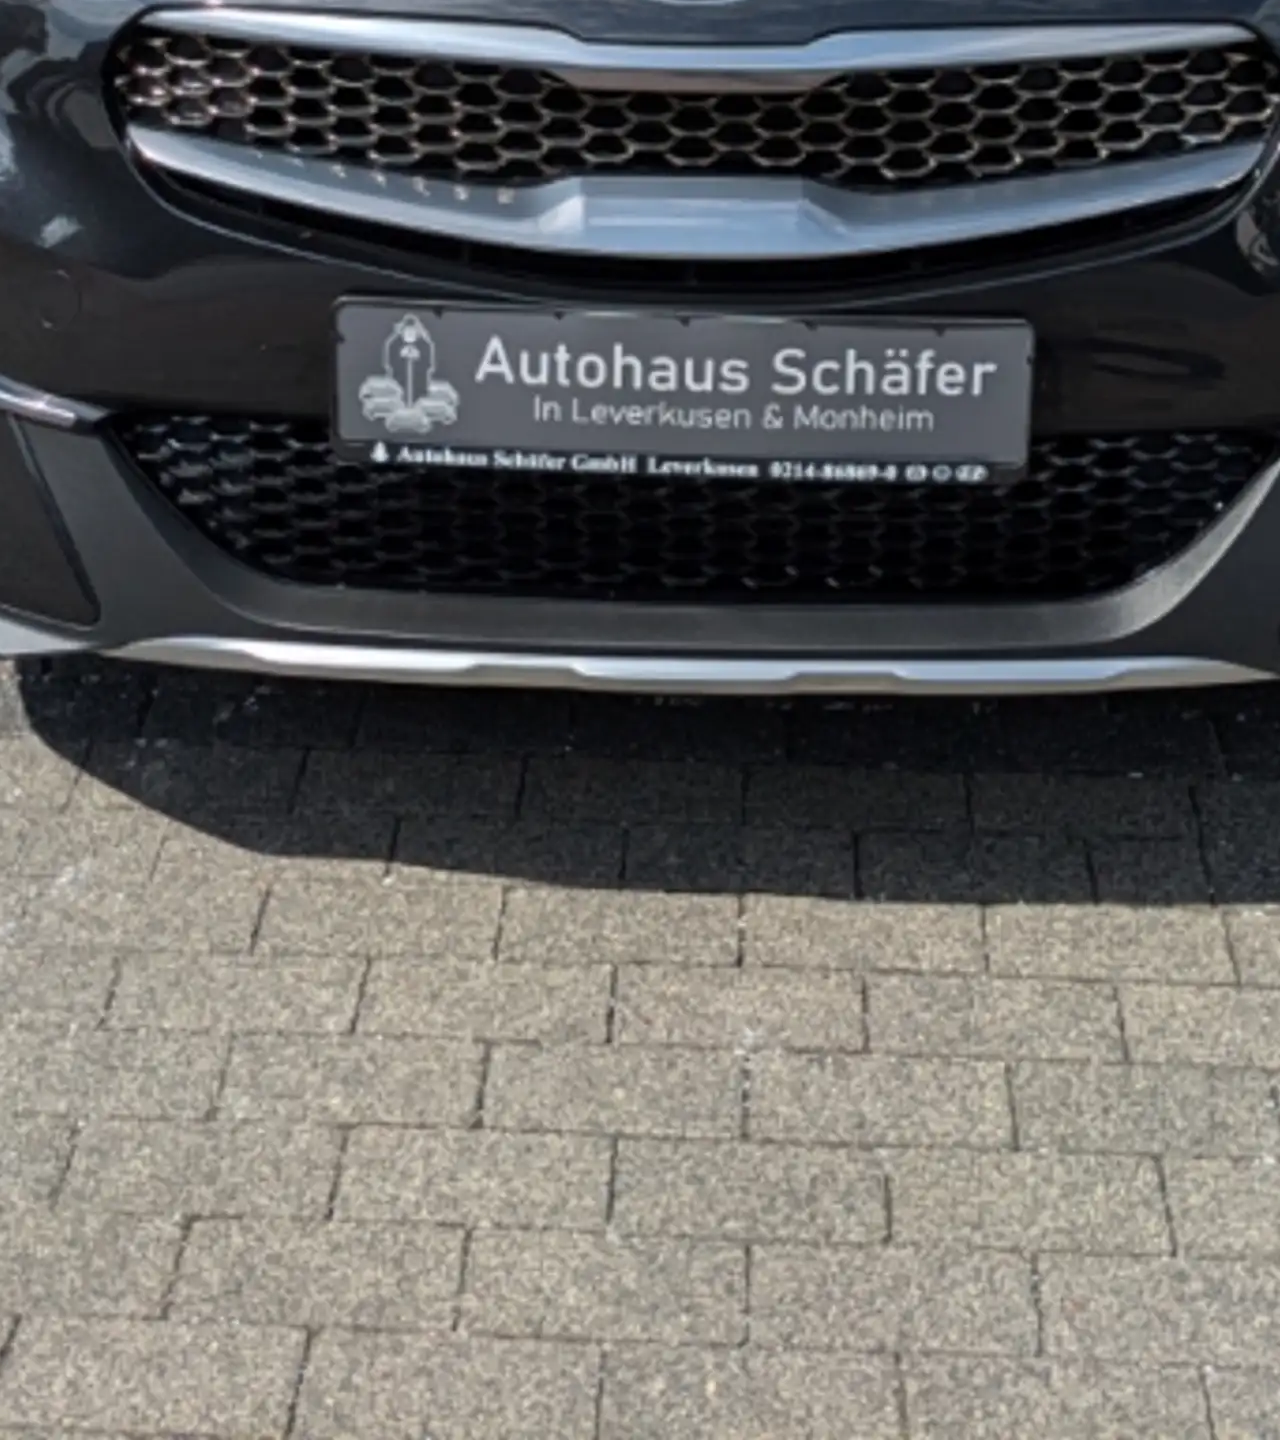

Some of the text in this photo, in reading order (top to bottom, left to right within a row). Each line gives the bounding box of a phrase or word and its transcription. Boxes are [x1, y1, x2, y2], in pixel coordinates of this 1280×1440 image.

[475, 335, 998, 397] Autohaus Schäfer
[533, 394, 935, 432] In Leverkusen & Monheim
[397, 444, 488, 466] Autohaus
[493, 448, 566, 471] Schäfer
[572, 453, 638, 474] GmbH
[647, 456, 759, 478] Leverkusen
